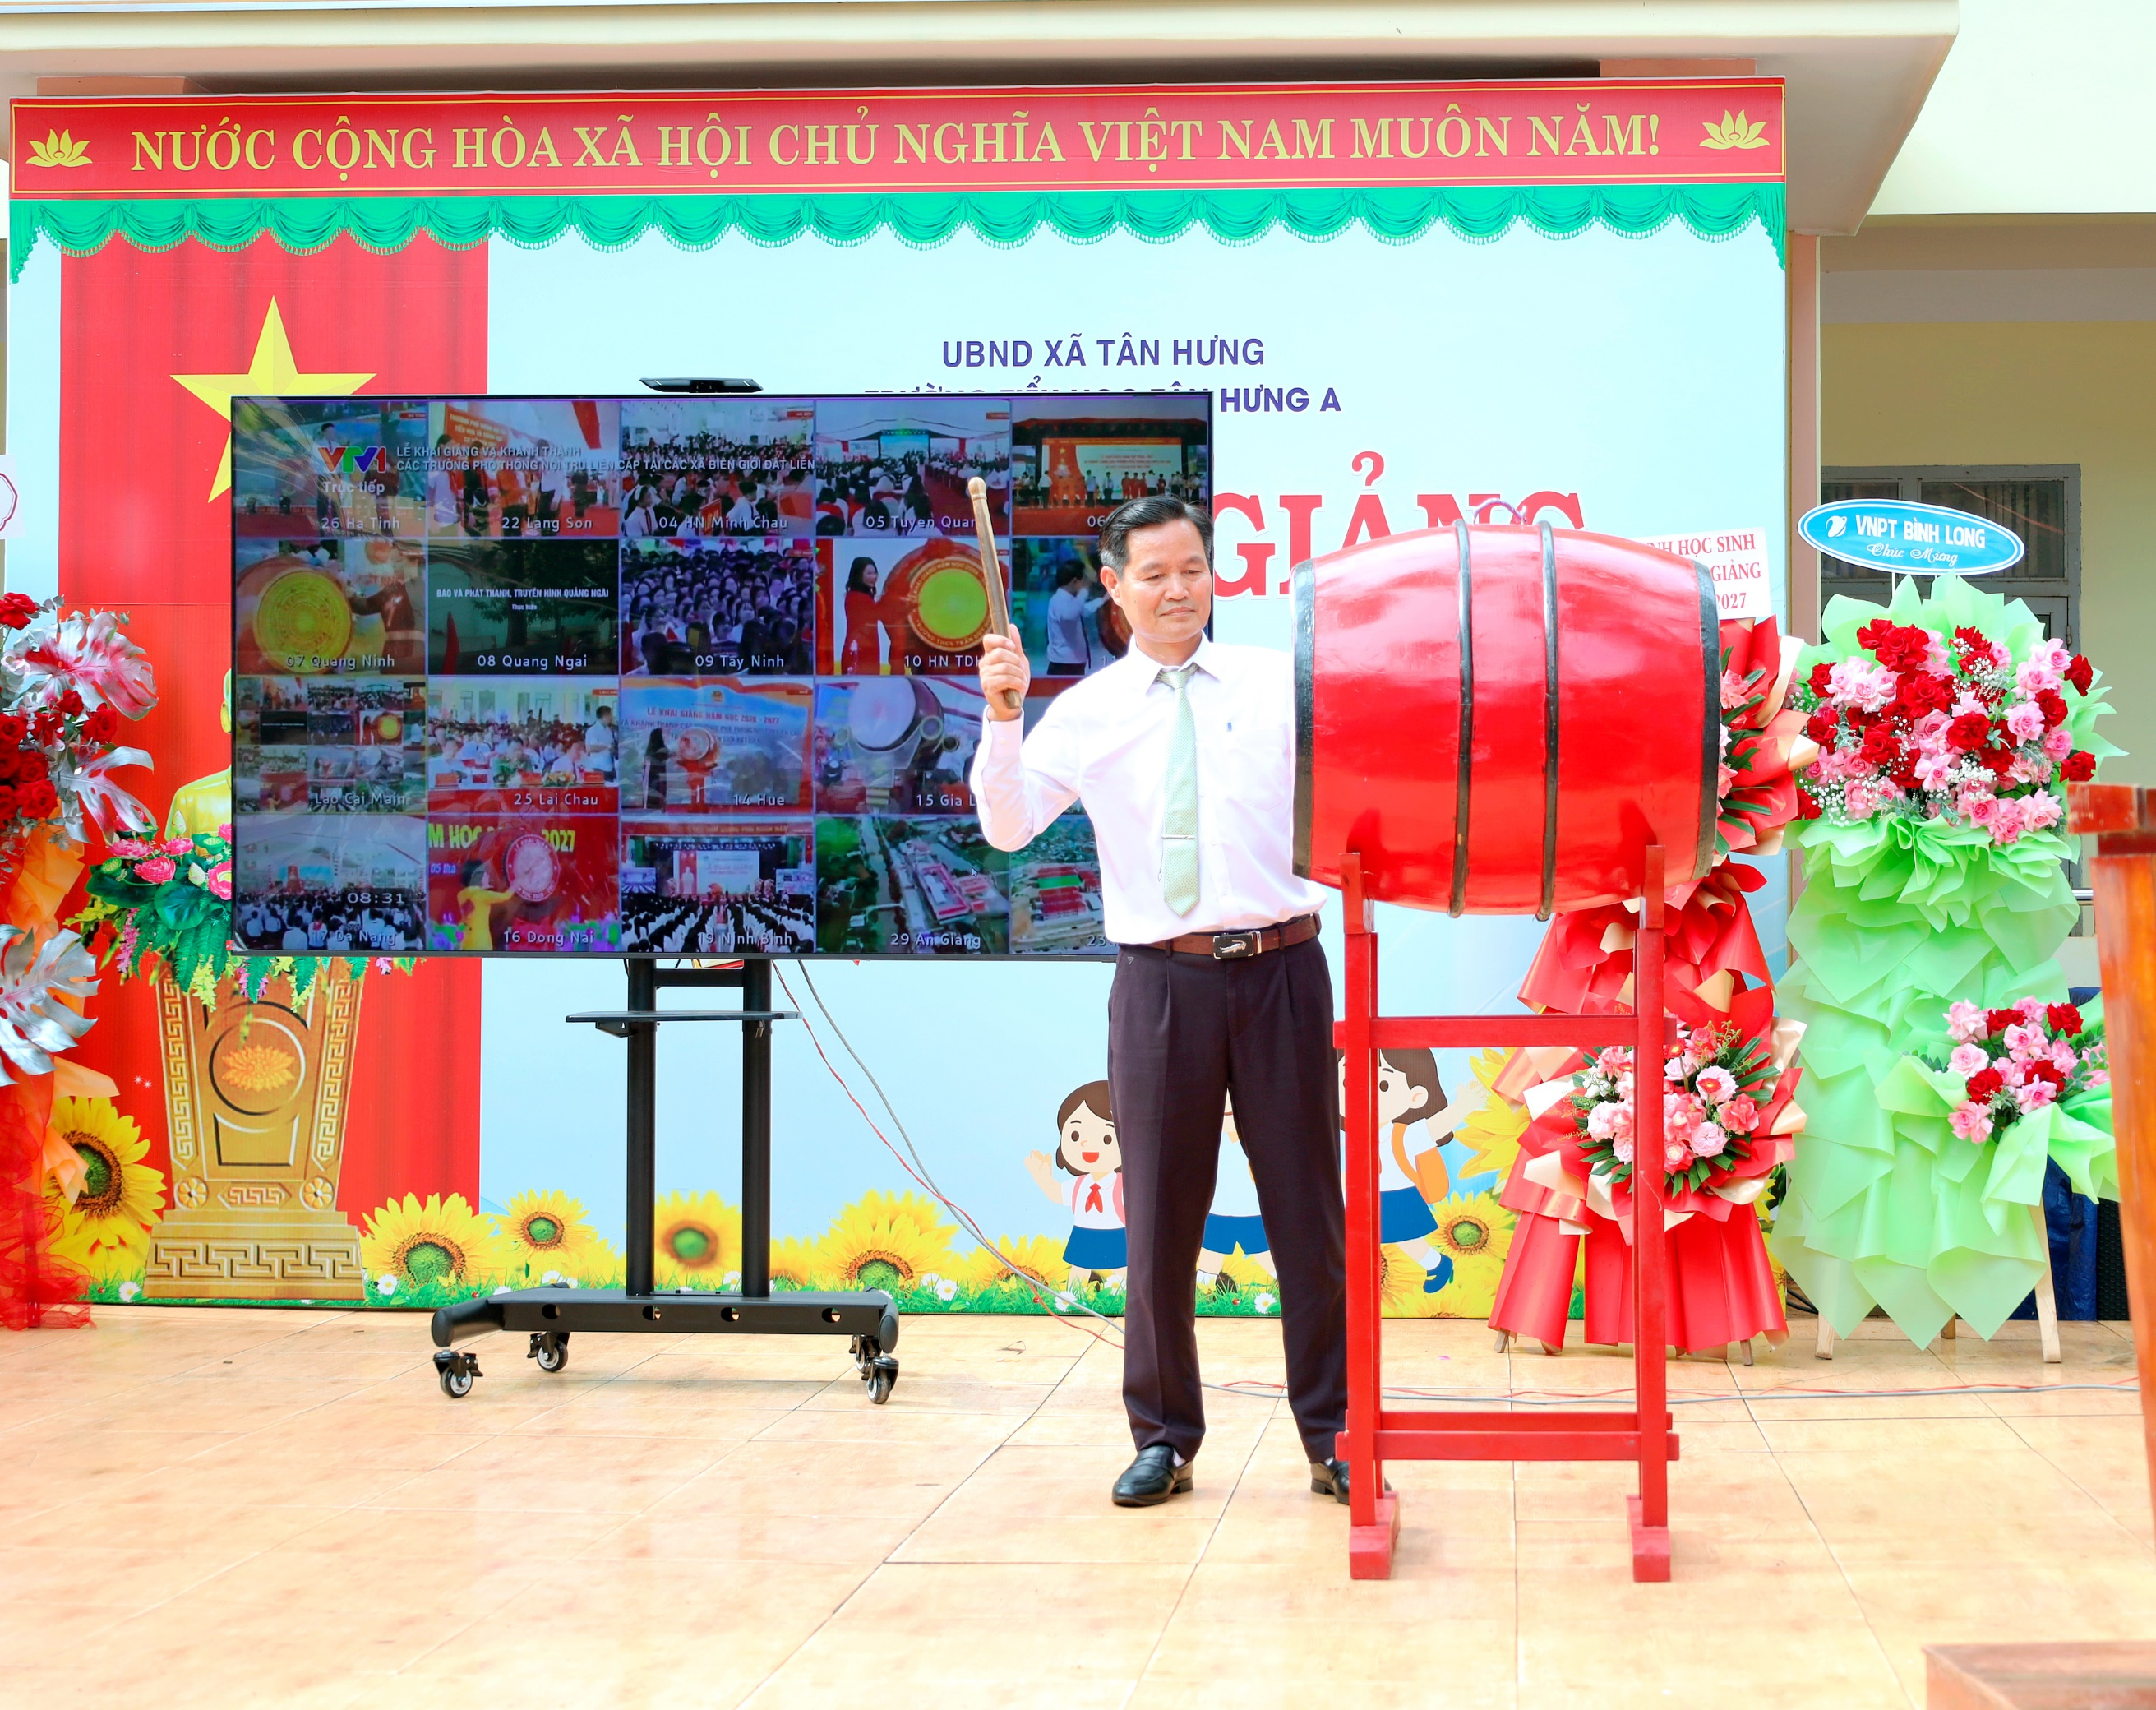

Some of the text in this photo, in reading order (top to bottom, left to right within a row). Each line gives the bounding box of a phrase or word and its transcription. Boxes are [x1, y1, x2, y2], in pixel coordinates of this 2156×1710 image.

[131, 102, 1660, 182] NƯỚC CỘNG HÒA XÃ HỘI CHỦ NGHĨA VIỆT NAM MUÔN NĂM!
[942, 331, 1265, 368] UBND XÃ TÂN HƯNG
[1221, 386, 1342, 413] HƯNG A
[397, 442, 410, 457] LỄ
[413, 447, 441, 457] KHAI
[397, 458, 420, 471] CÁC
[709, 458, 735, 470] BIÊN
[358, 479, 385, 496] tiếp
[321, 516, 400, 529] 26 Ha Tinh
[502, 516, 592, 533] 22 Lang Son
[659, 515, 788, 529] 04 HN Minh Chau
[866, 515, 884, 528] 05
[891, 515, 935, 533] Tuyen
[1087, 515, 1106, 528] 06
[1855, 514, 1986, 548] VNPT BÌNH LONG
[1678, 537, 1712, 558] HỌC
[1717, 534, 1756, 552] SINH
[1866, 543, 1959, 567] Chúc Mừng
[1710, 559, 1761, 582] GIẢNG
[286, 654, 395, 671] 07 Quang Ninh
[477, 654, 587, 671] 08 Quang Ngai
[695, 654, 784, 671] 09 Tay Ninh
[904, 655, 921, 667] 10
[928, 655, 949, 667] HN
[315, 792, 405, 805] Lao Cai Main
[514, 793, 598, 805] 25 Lai Chau
[733, 793, 785, 806] 14 Hue
[916, 794, 934, 806] 15
[940, 794, 963, 806] Gia
[347, 892, 405, 904] 08:31
[312, 930, 395, 946] 17 Da Nang
[503, 930, 593, 947] 16 Dong Nai
[697, 932, 792, 945] 19 Ninh Binh
[891, 932, 981, 950] 29 An Giang
[1087, 935, 1106, 947] 23
